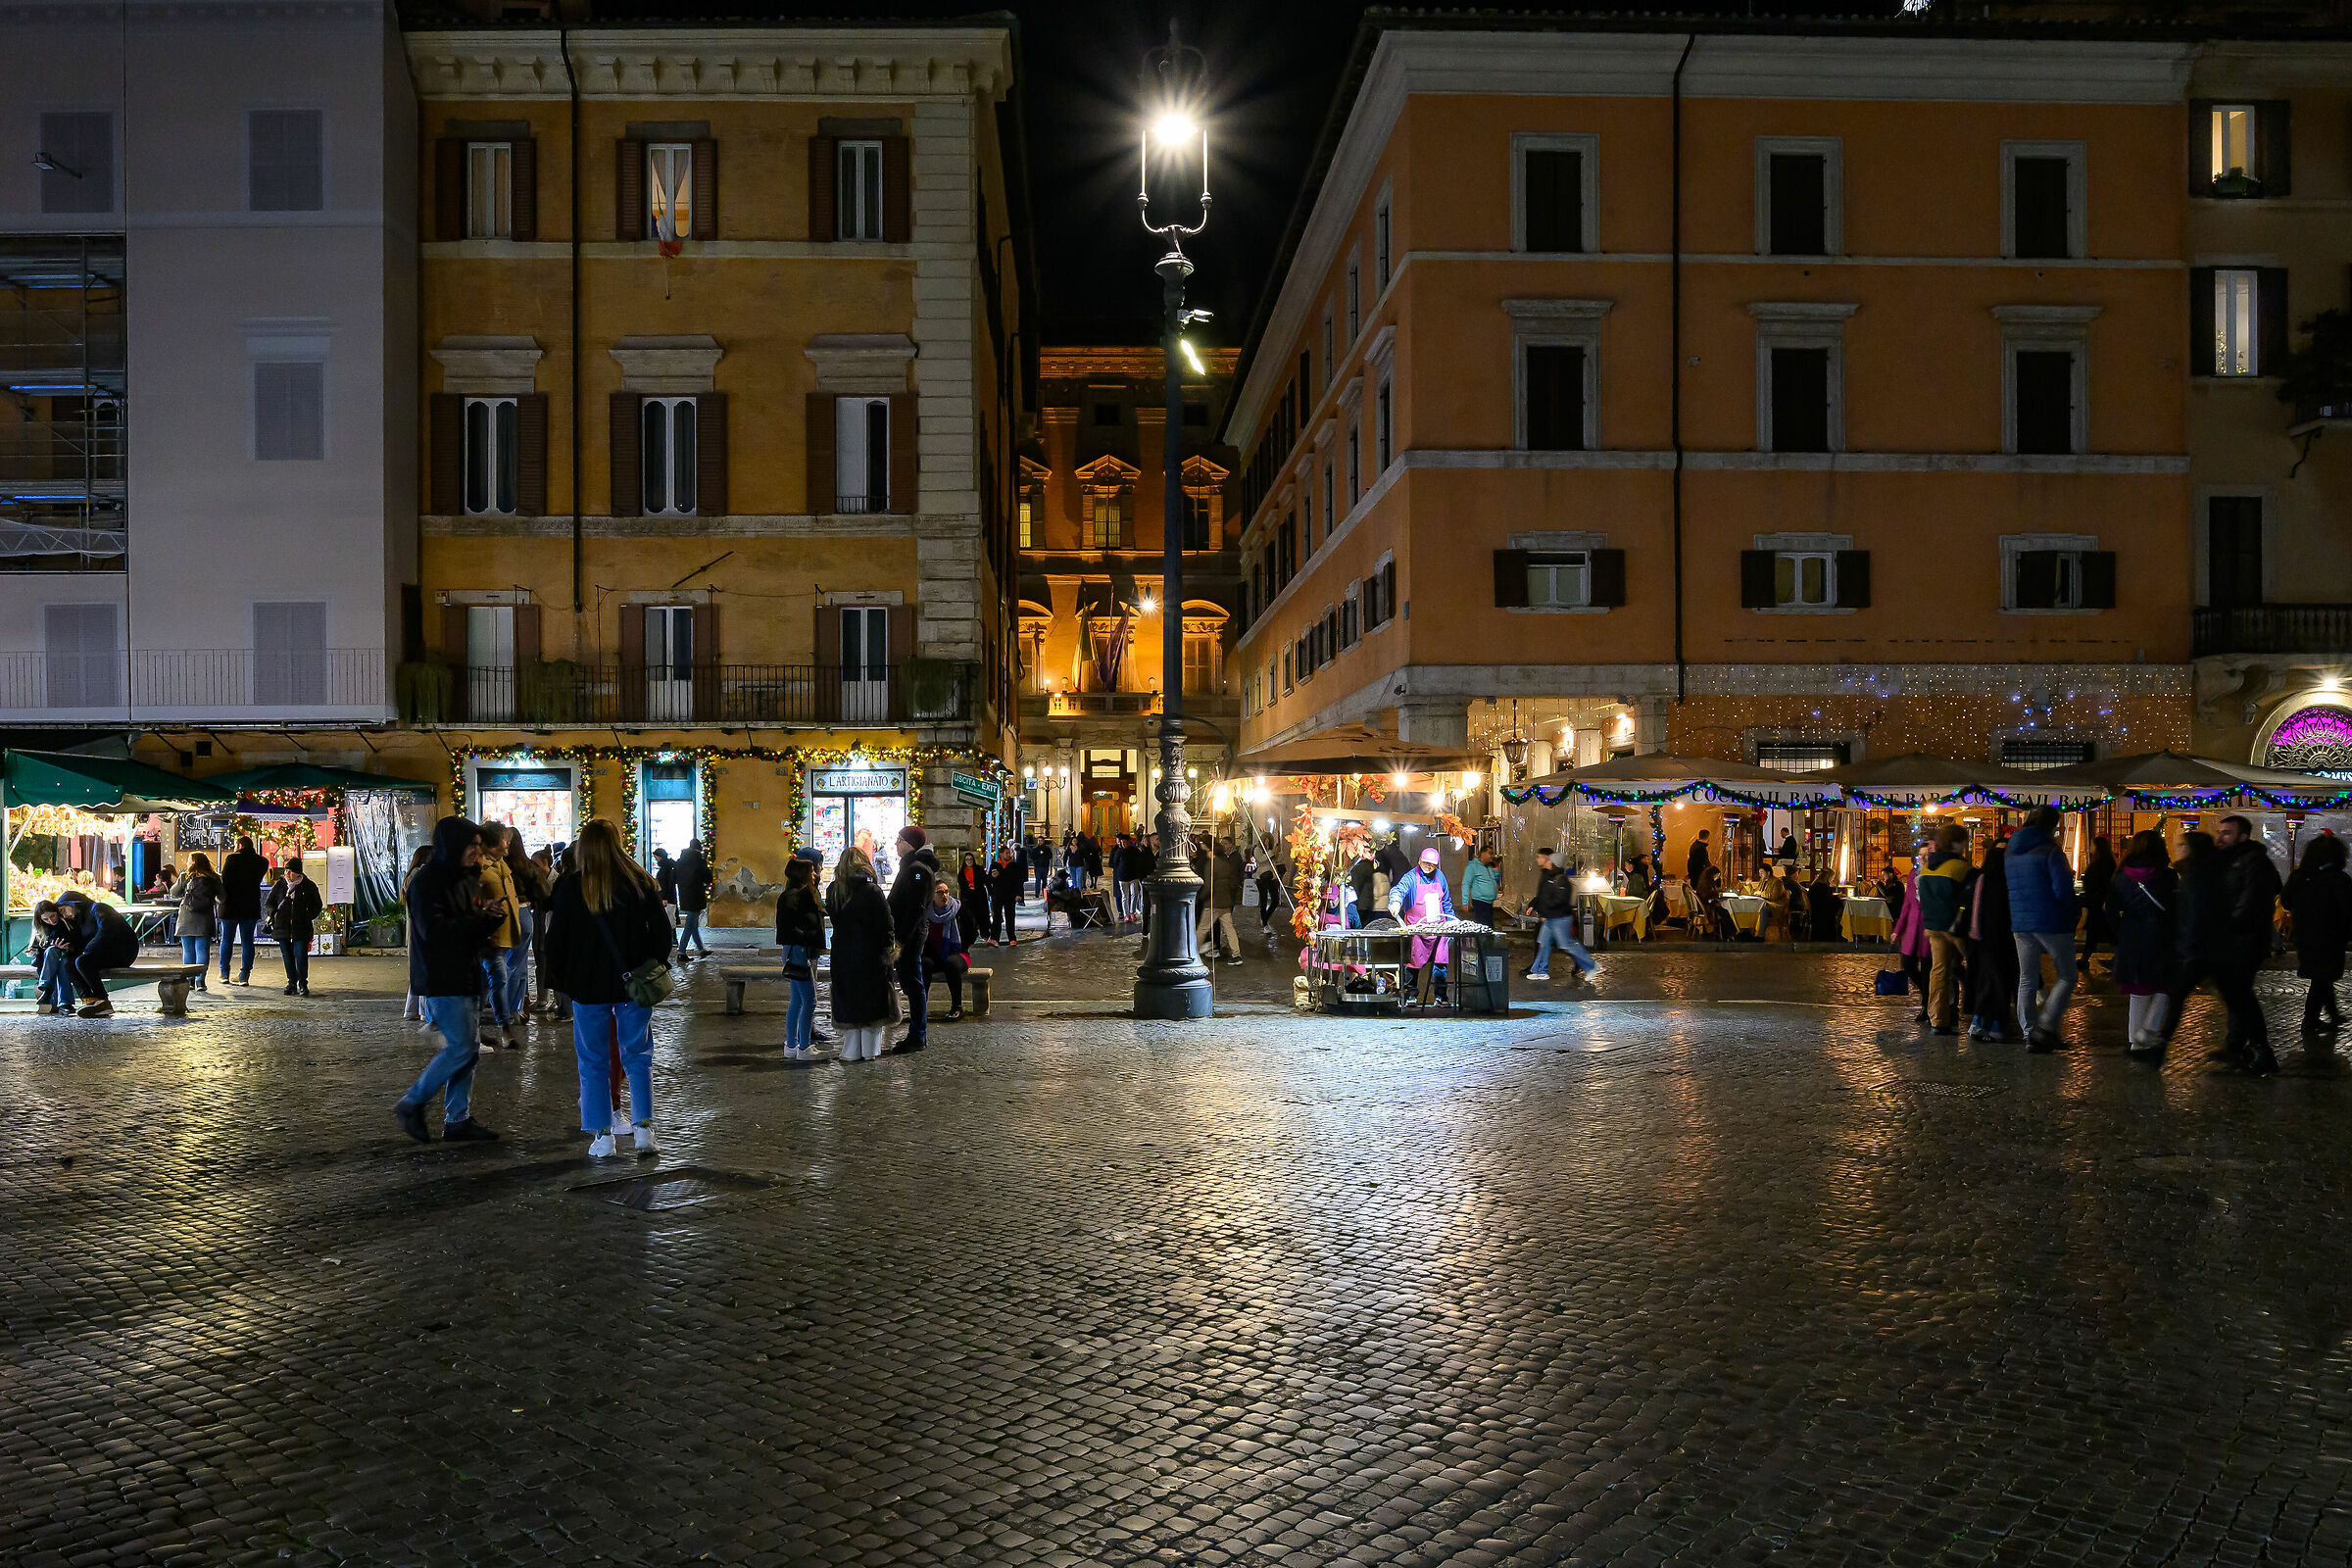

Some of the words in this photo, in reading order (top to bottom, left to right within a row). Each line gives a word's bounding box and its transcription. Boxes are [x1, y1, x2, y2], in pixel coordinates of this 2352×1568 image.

[829, 775, 889, 787] L'ARTIGIANATO
[954, 774, 976, 787] USCITA
[981, 783, 998, 793] EXIT
[1581, 789, 1631, 803] WE
[1852, 792, 1899, 807] WE
